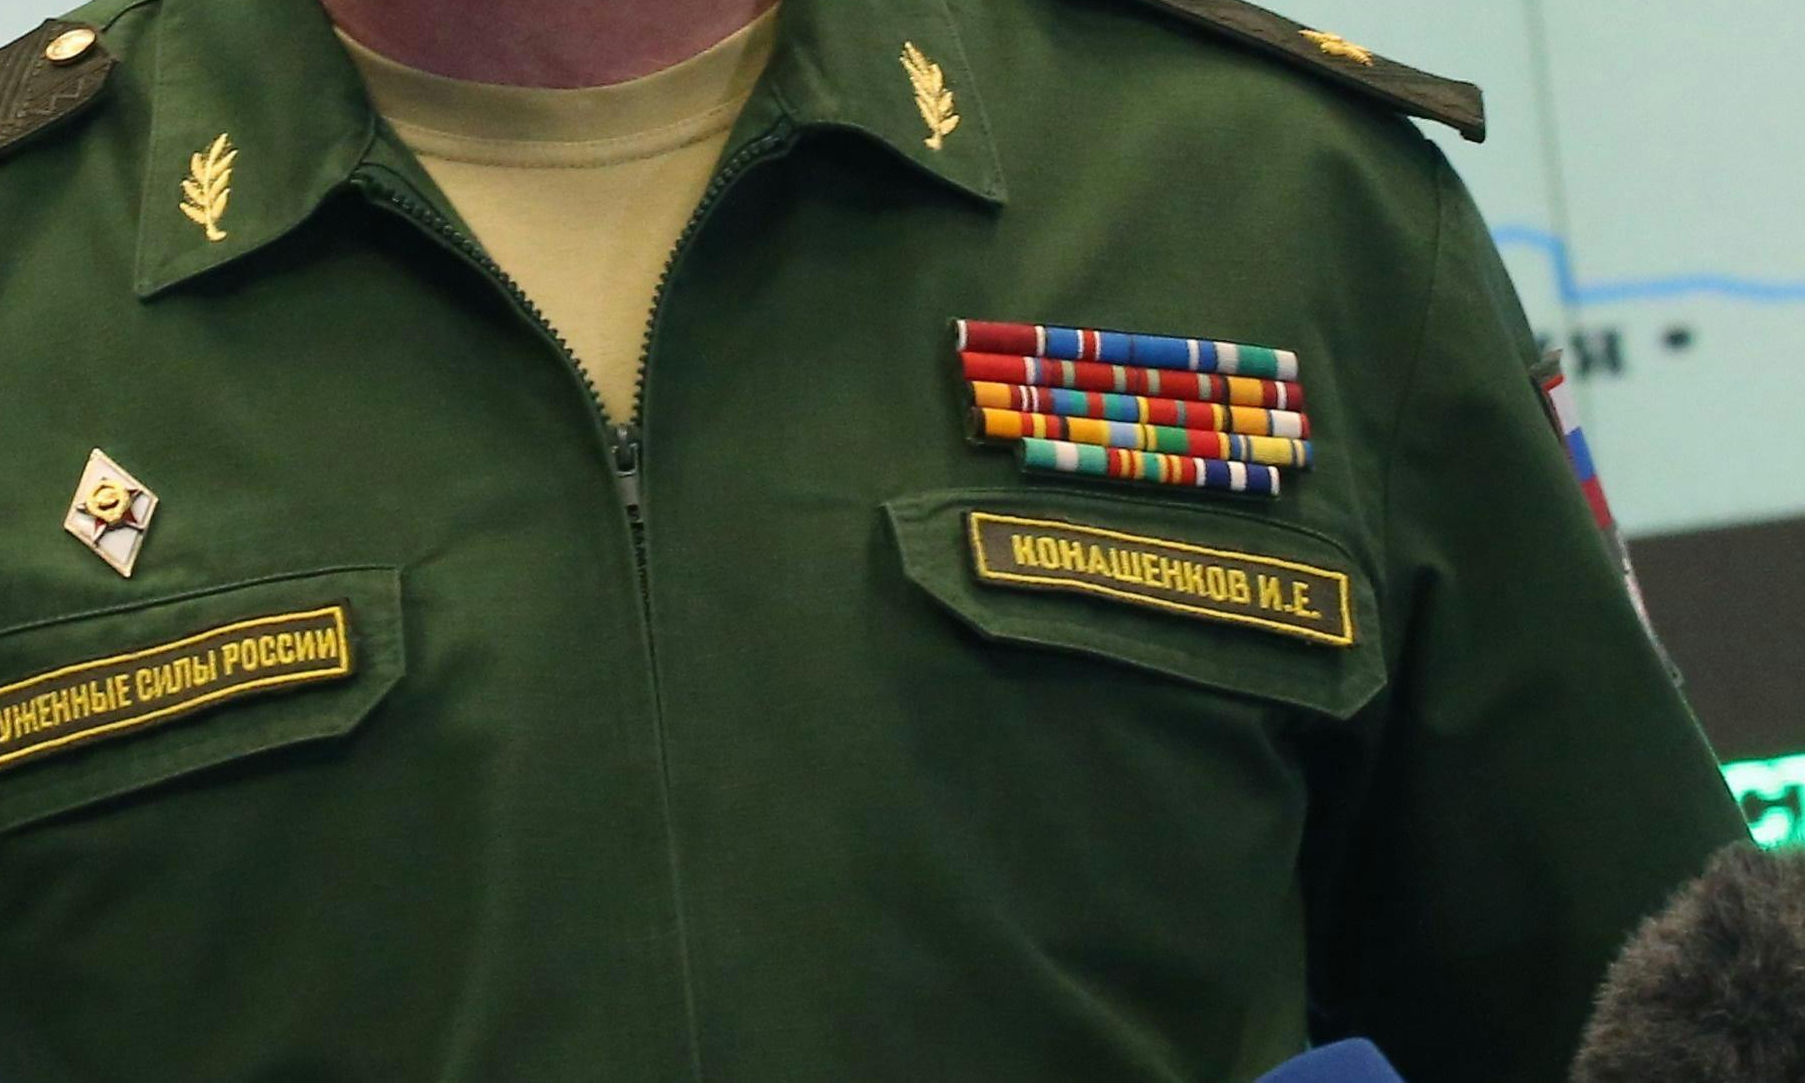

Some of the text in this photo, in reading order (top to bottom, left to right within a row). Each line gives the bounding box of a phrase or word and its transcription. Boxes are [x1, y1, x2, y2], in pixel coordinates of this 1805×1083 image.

[1010, 533, 1323, 618] КОНАШЕНКОВ И.Е.
[135, 649, 218, 703] СИЛЫ
[221, 626, 338, 677] РОССИИ
